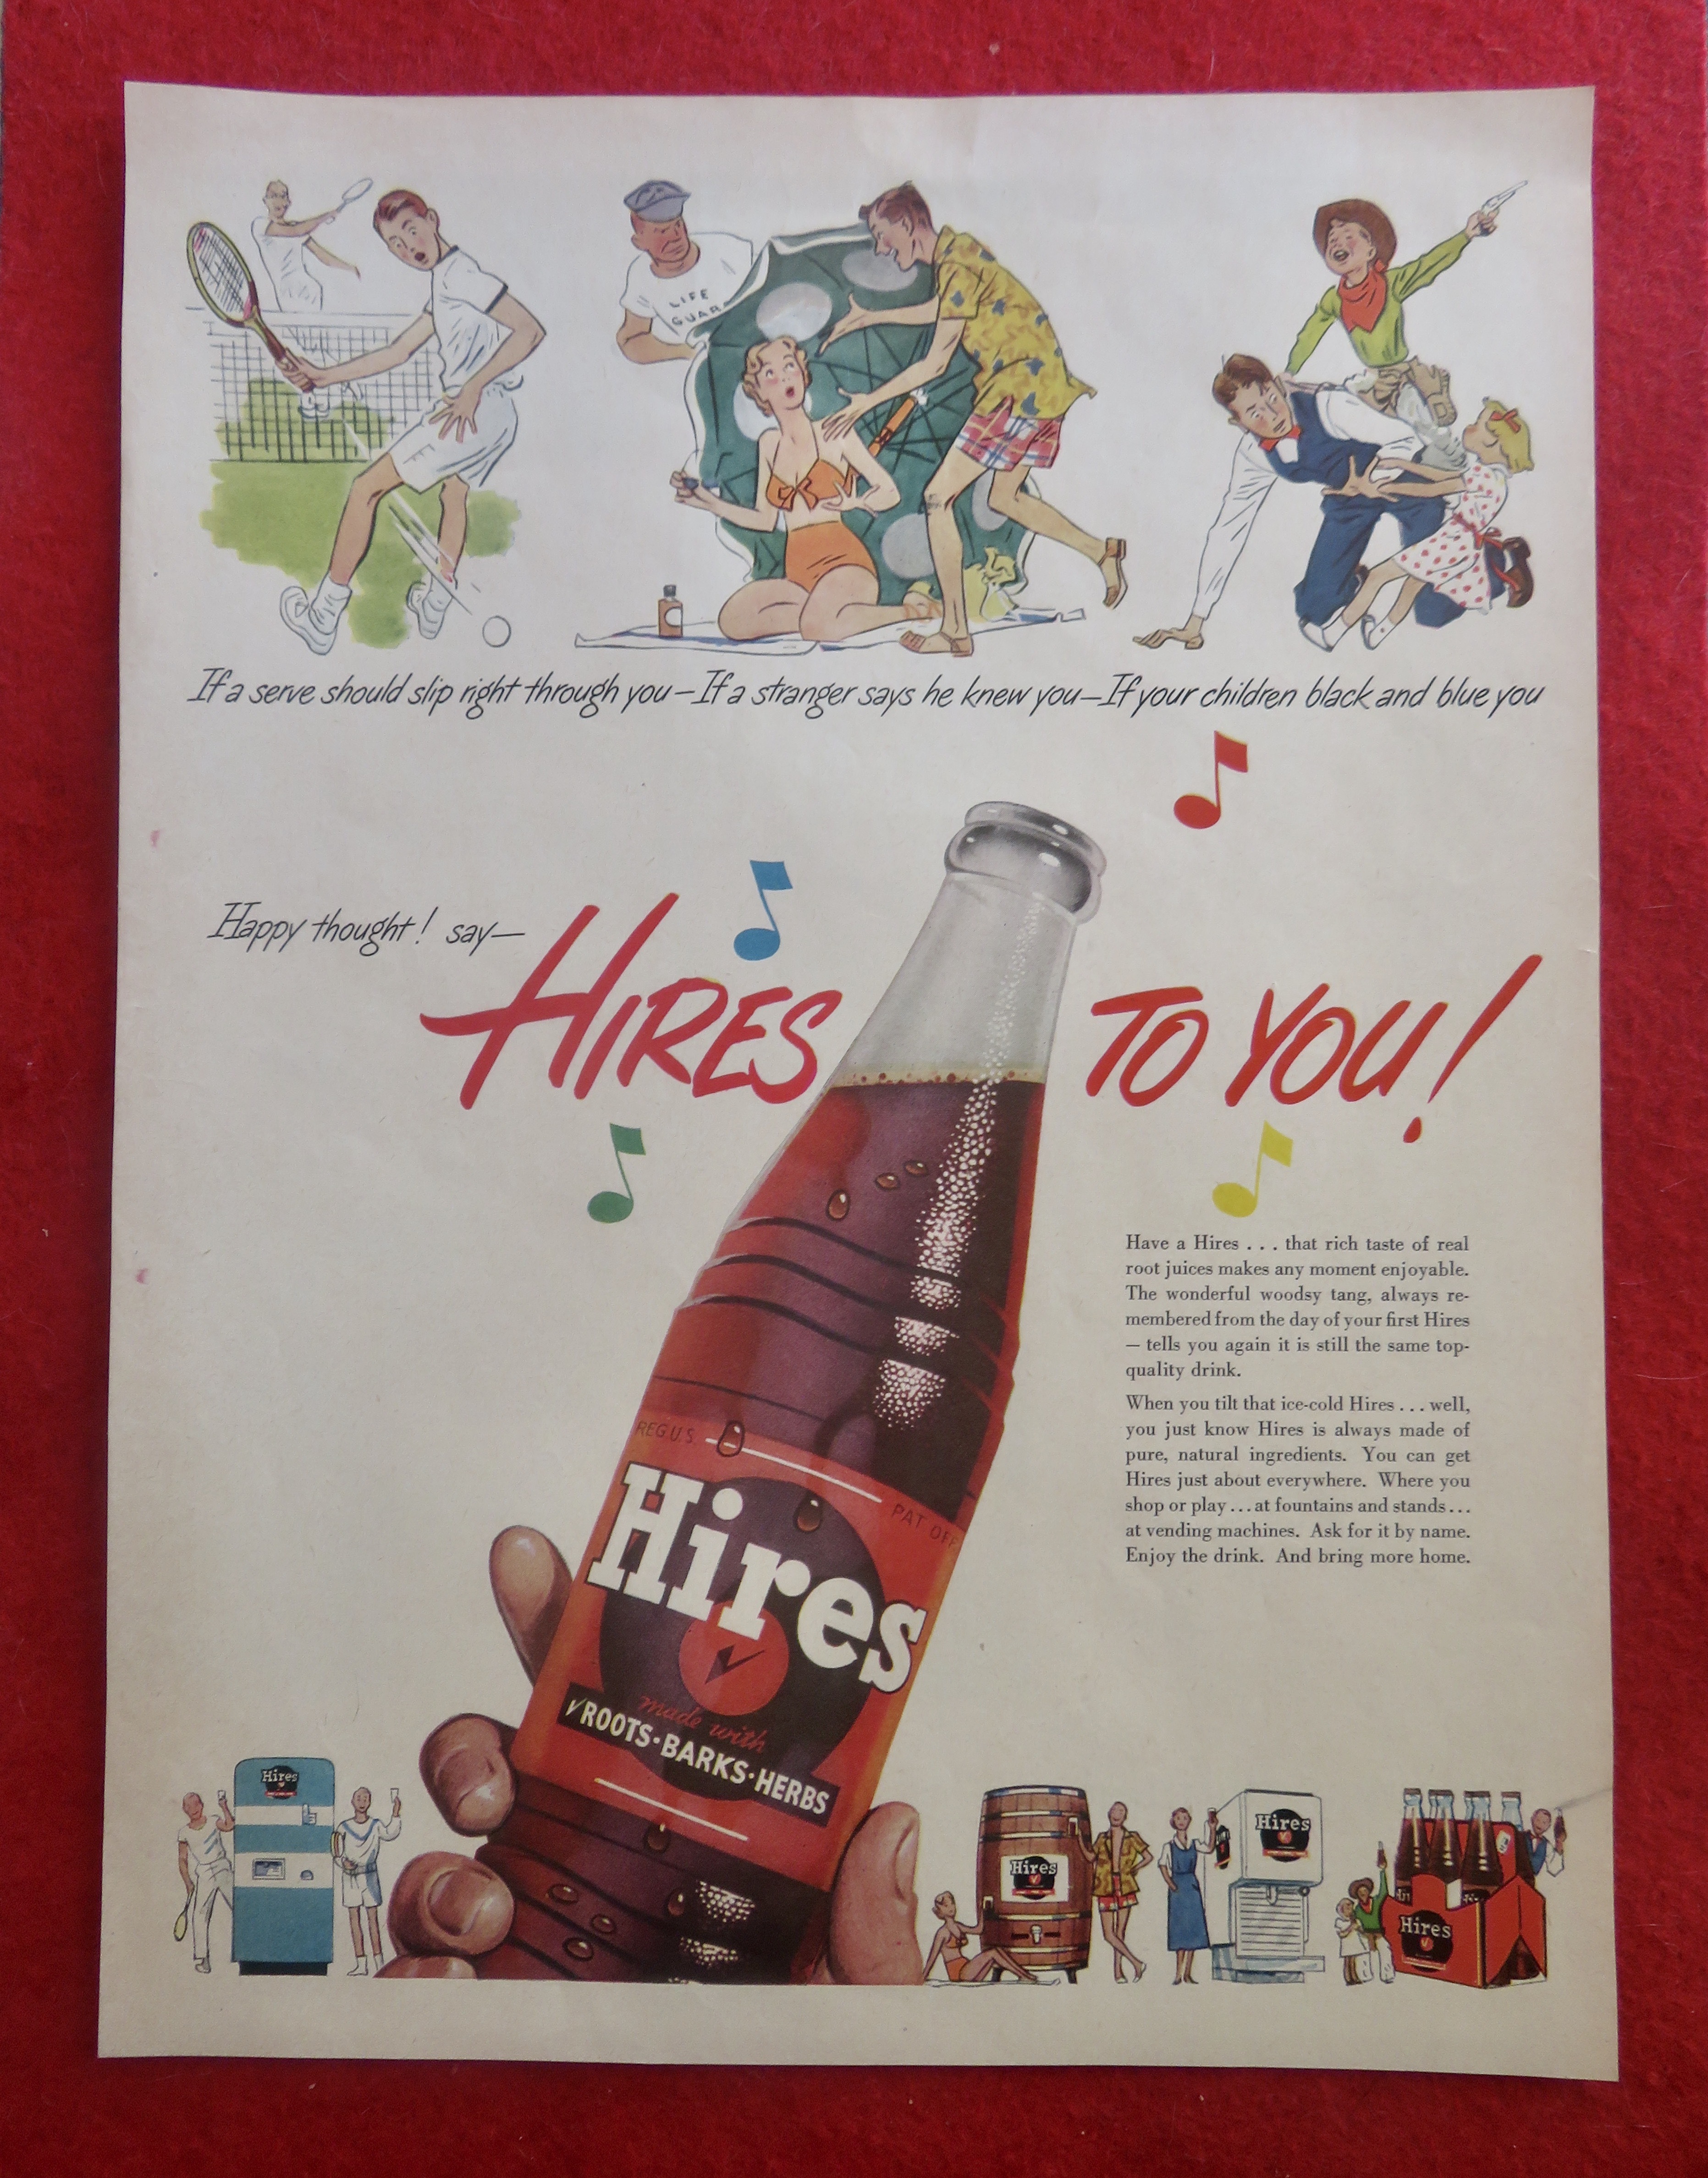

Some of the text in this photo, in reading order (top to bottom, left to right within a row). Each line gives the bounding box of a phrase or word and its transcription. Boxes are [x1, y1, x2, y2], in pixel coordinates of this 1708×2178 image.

[668, 288, 709, 308] LIFE
[186, 666, 234, 704] If
[223, 682, 245, 704] a
[248, 683, 317, 706] serve
[319, 672, 414, 705] should
[407, 674, 455, 718] slip
[458, 673, 523, 721] right
[523, 670, 621, 720] through
[726, 684, 747, 706] a
[750, 675, 860, 720] stranger
[857, 685, 917, 718] says
[920, 673, 955, 709] he
[959, 674, 1034, 709] knew
[1129, 685, 1201, 719] your
[1199, 675, 1299, 710] children
[1304, 674, 1375, 710] black
[1374, 675, 1438, 709] and
[1435, 675, 1492, 709] blue
[1486, 684, 1547, 720] you
[205, 901, 309, 954] Happy
[419, 893, 843, 1105] HIRES
[1085, 986, 1210, 1107] TO
[1124, 1233, 1170, 1251] Have
[1176, 1239, 1187, 1251] a
[1193, 1233, 1240, 1251] Hires
[1284, 1234, 1318, 1251] that
[1324, 1234, 1360, 1251] rich
[1365, 1238, 1405, 1252] taste
[1411, 1235, 1430, 1252] of
[1436, 1235, 1470, 1252] real
[1125, 1259, 1470, 1282] root juices makes any moment enjoyable.
[1124, 1284, 1470, 1307] The wonderful woodsy tang, always re-
[1125, 1309, 1471, 1331] membered from the day of your first Hires
[1146, 1334, 1181, 1352] tells
[1186, 1341, 1218, 1357] you
[1224, 1336, 1271, 1357] again
[1277, 1336, 1291, 1353] it
[1296, 1336, 1311, 1352] is
[1316, 1335, 1350, 1353] still
[1355, 1335, 1382, 1353] the
[1387, 1342, 1431, 1353] same
[1435, 1339, 1470, 1358] top-
[1125, 1359, 1242, 1382] quality drink.
[1125, 1394, 1174, 1411] When
[1178, 1400, 1210, 1416] you
[1214, 1394, 1239, 1411] tilt
[1242, 1394, 1276, 1411] that
[1280, 1395, 1344, 1412] ice-cold
[1349, 1395, 1395, 1412] Hires
[1428, 1395, 1471, 1415] well,
[1125, 1419, 1471, 1442] you just know Hires is always made of
[1124, 1445, 1471, 1468] pure, natural ingredients. You can get
[1124, 1470, 1471, 1493] Hires just about everywhere. Where you
[892, 1502, 925, 1528] PAT
[1124, 1495, 1165, 1518] shop
[1168, 1501, 1188, 1512] or
[1190, 1495, 1228, 1518] play
[1254, 1499, 1271, 1512] at
[1274, 1496, 1354, 1513] fountains
[1357, 1496, 1389, 1513] and
[1125, 1520, 1471, 1543] at vending machines. Ask for it by name.
[1125, 1546, 1471, 1568] Enjoy the drink. And bring more home.
[585, 1461, 928, 1694] Hires
[638, 1695, 768, 1754] made with
[261, 1769, 298, 1782] Hires
[1256, 1813, 1310, 1831] Hires
[1010, 1860, 1057, 1875] Hires
[1399, 1915, 1452, 1939] Hires
